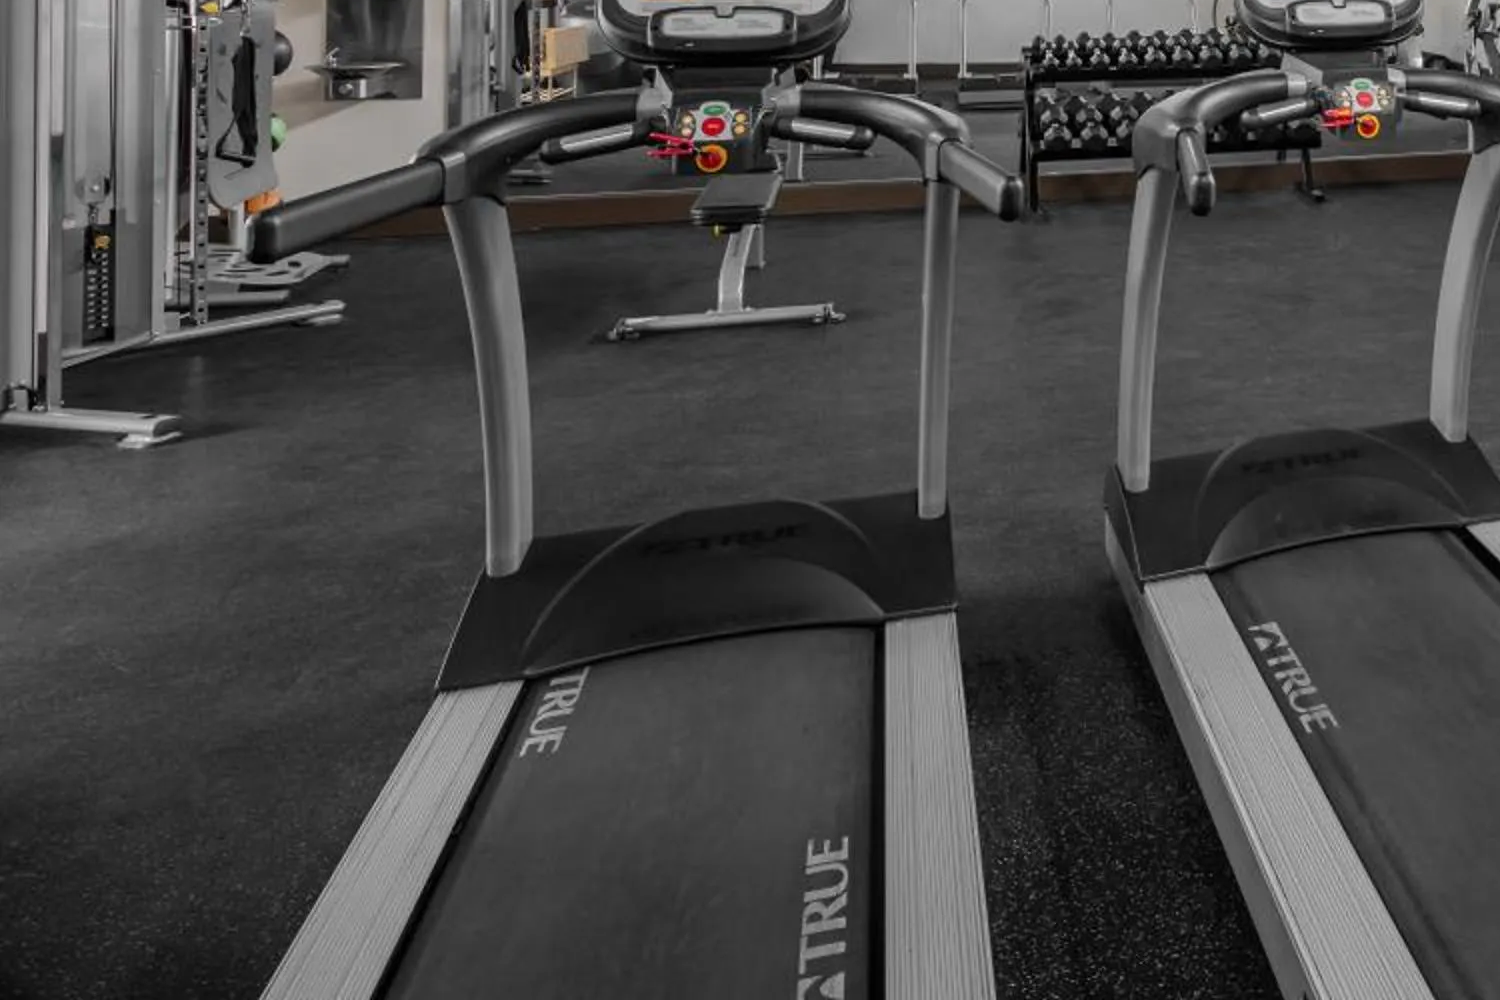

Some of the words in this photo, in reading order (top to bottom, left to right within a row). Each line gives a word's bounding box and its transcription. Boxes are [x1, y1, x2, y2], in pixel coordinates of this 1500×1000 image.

[519, 665, 592, 758] TRUE
[1266, 647, 1340, 734] TRUE
[798, 835, 850, 976] TRUE
